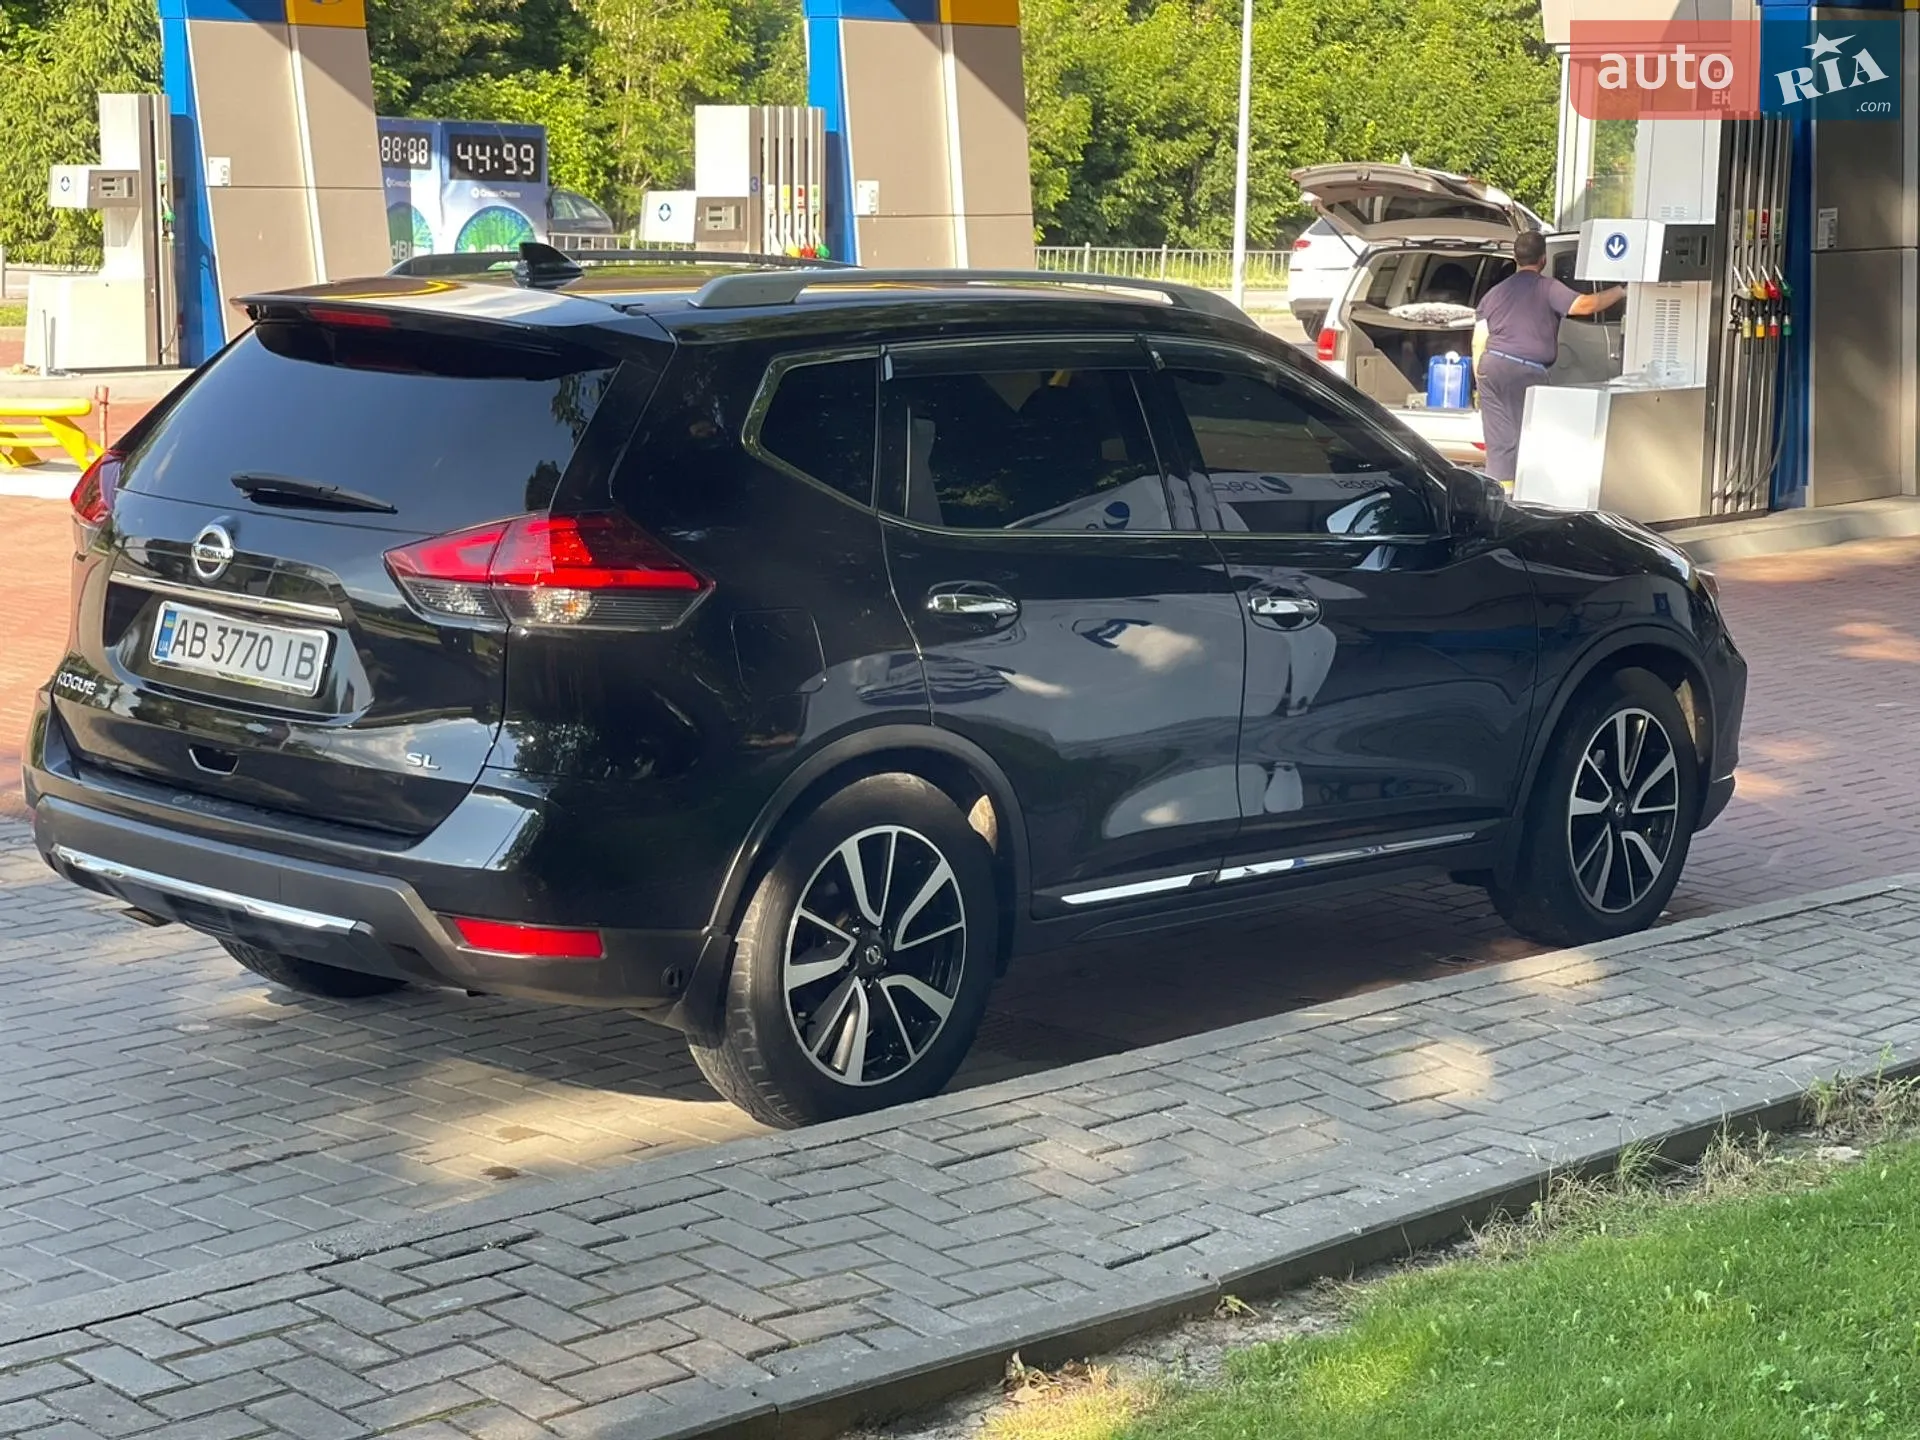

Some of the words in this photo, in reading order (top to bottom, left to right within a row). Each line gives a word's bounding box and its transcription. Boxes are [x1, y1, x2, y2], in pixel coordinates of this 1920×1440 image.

[171, 619, 208, 659] AB
[211, 625, 274, 672] 3770
[281, 638, 317, 681] IB
[406, 752, 441, 770] SL
